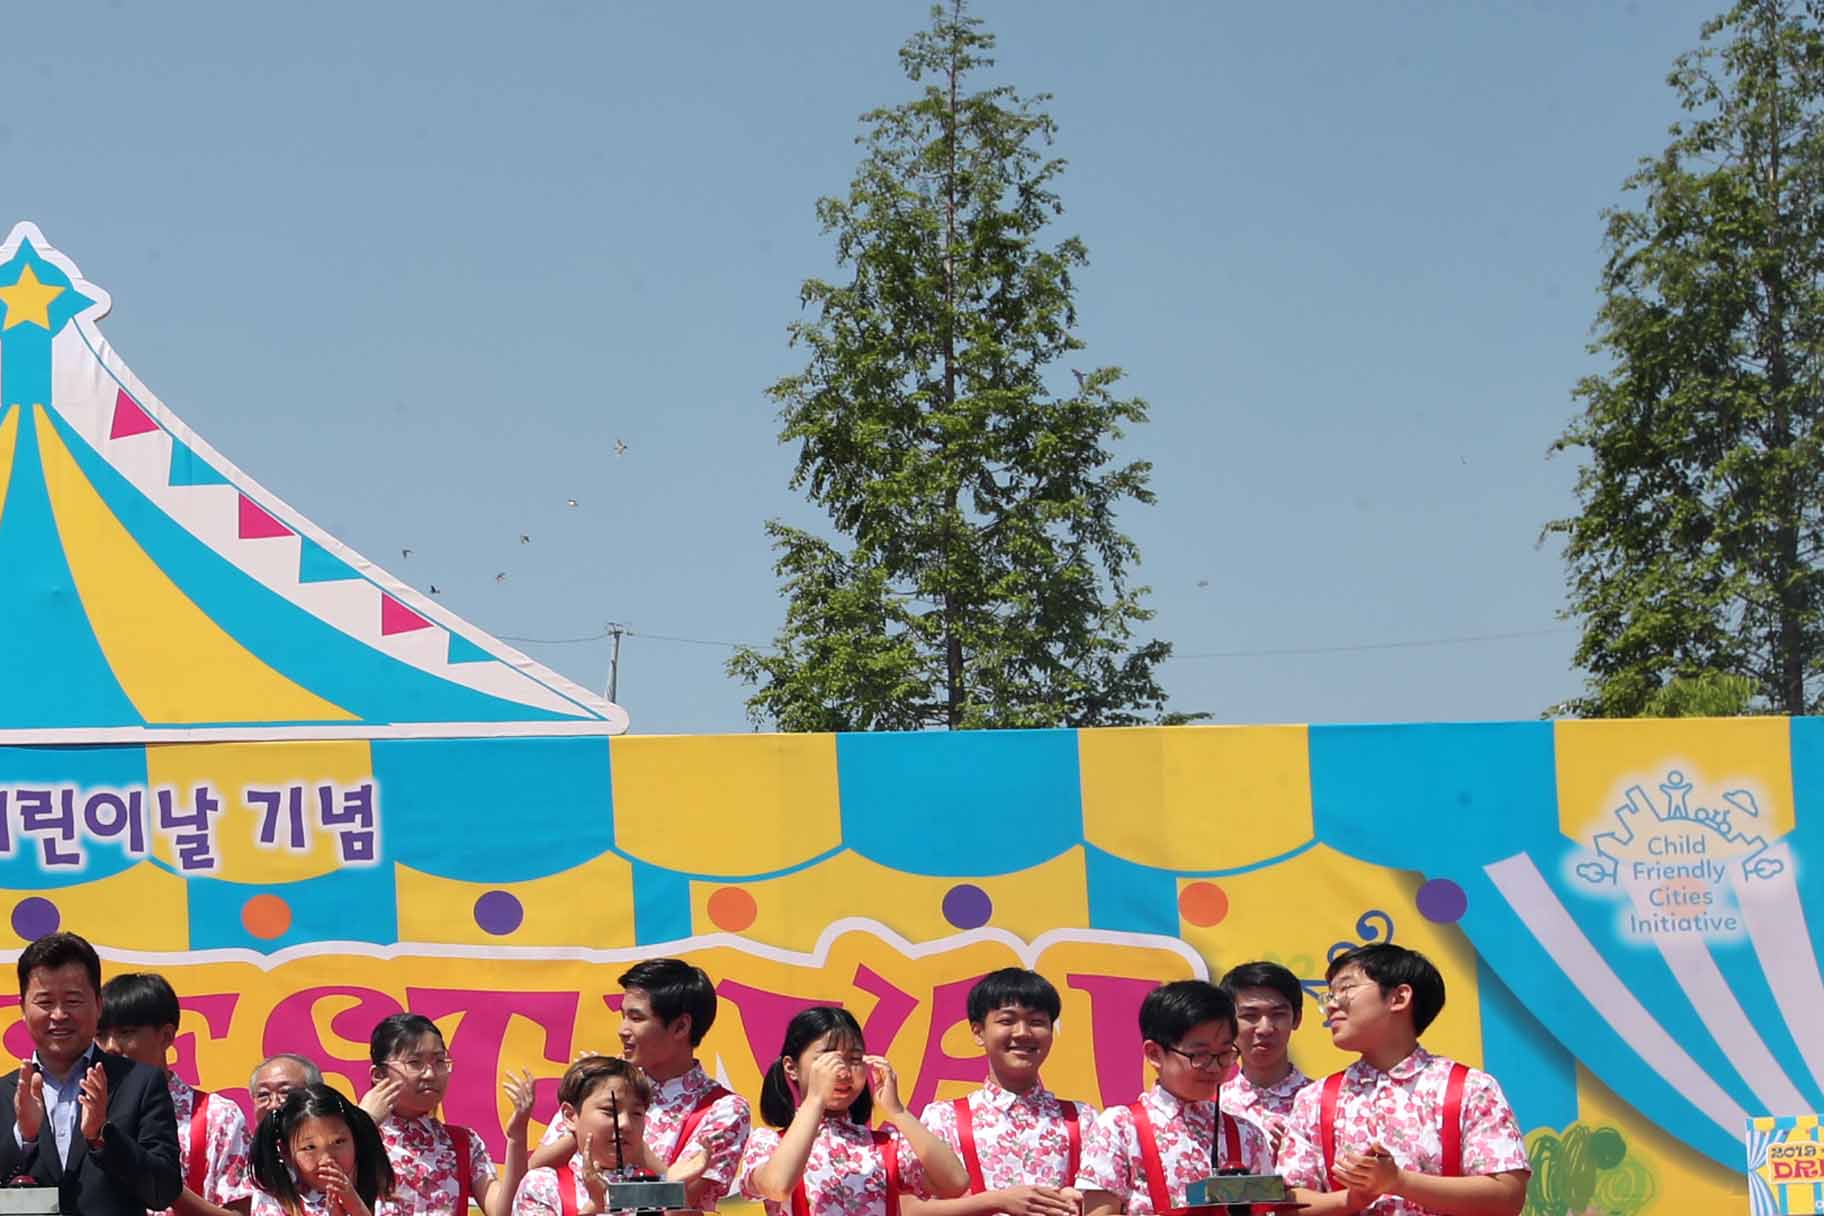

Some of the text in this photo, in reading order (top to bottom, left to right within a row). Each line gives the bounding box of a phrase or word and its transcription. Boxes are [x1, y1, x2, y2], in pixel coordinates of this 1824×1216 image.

[248, 784, 376, 864] 기념
[1647, 834, 1707, 856] Child
[1632, 859, 1726, 884] Friendly
[1648, 885, 1714, 907] Cities
[1630, 911, 1738, 933] Initiative
[1774, 1159, 1824, 1179] DR
